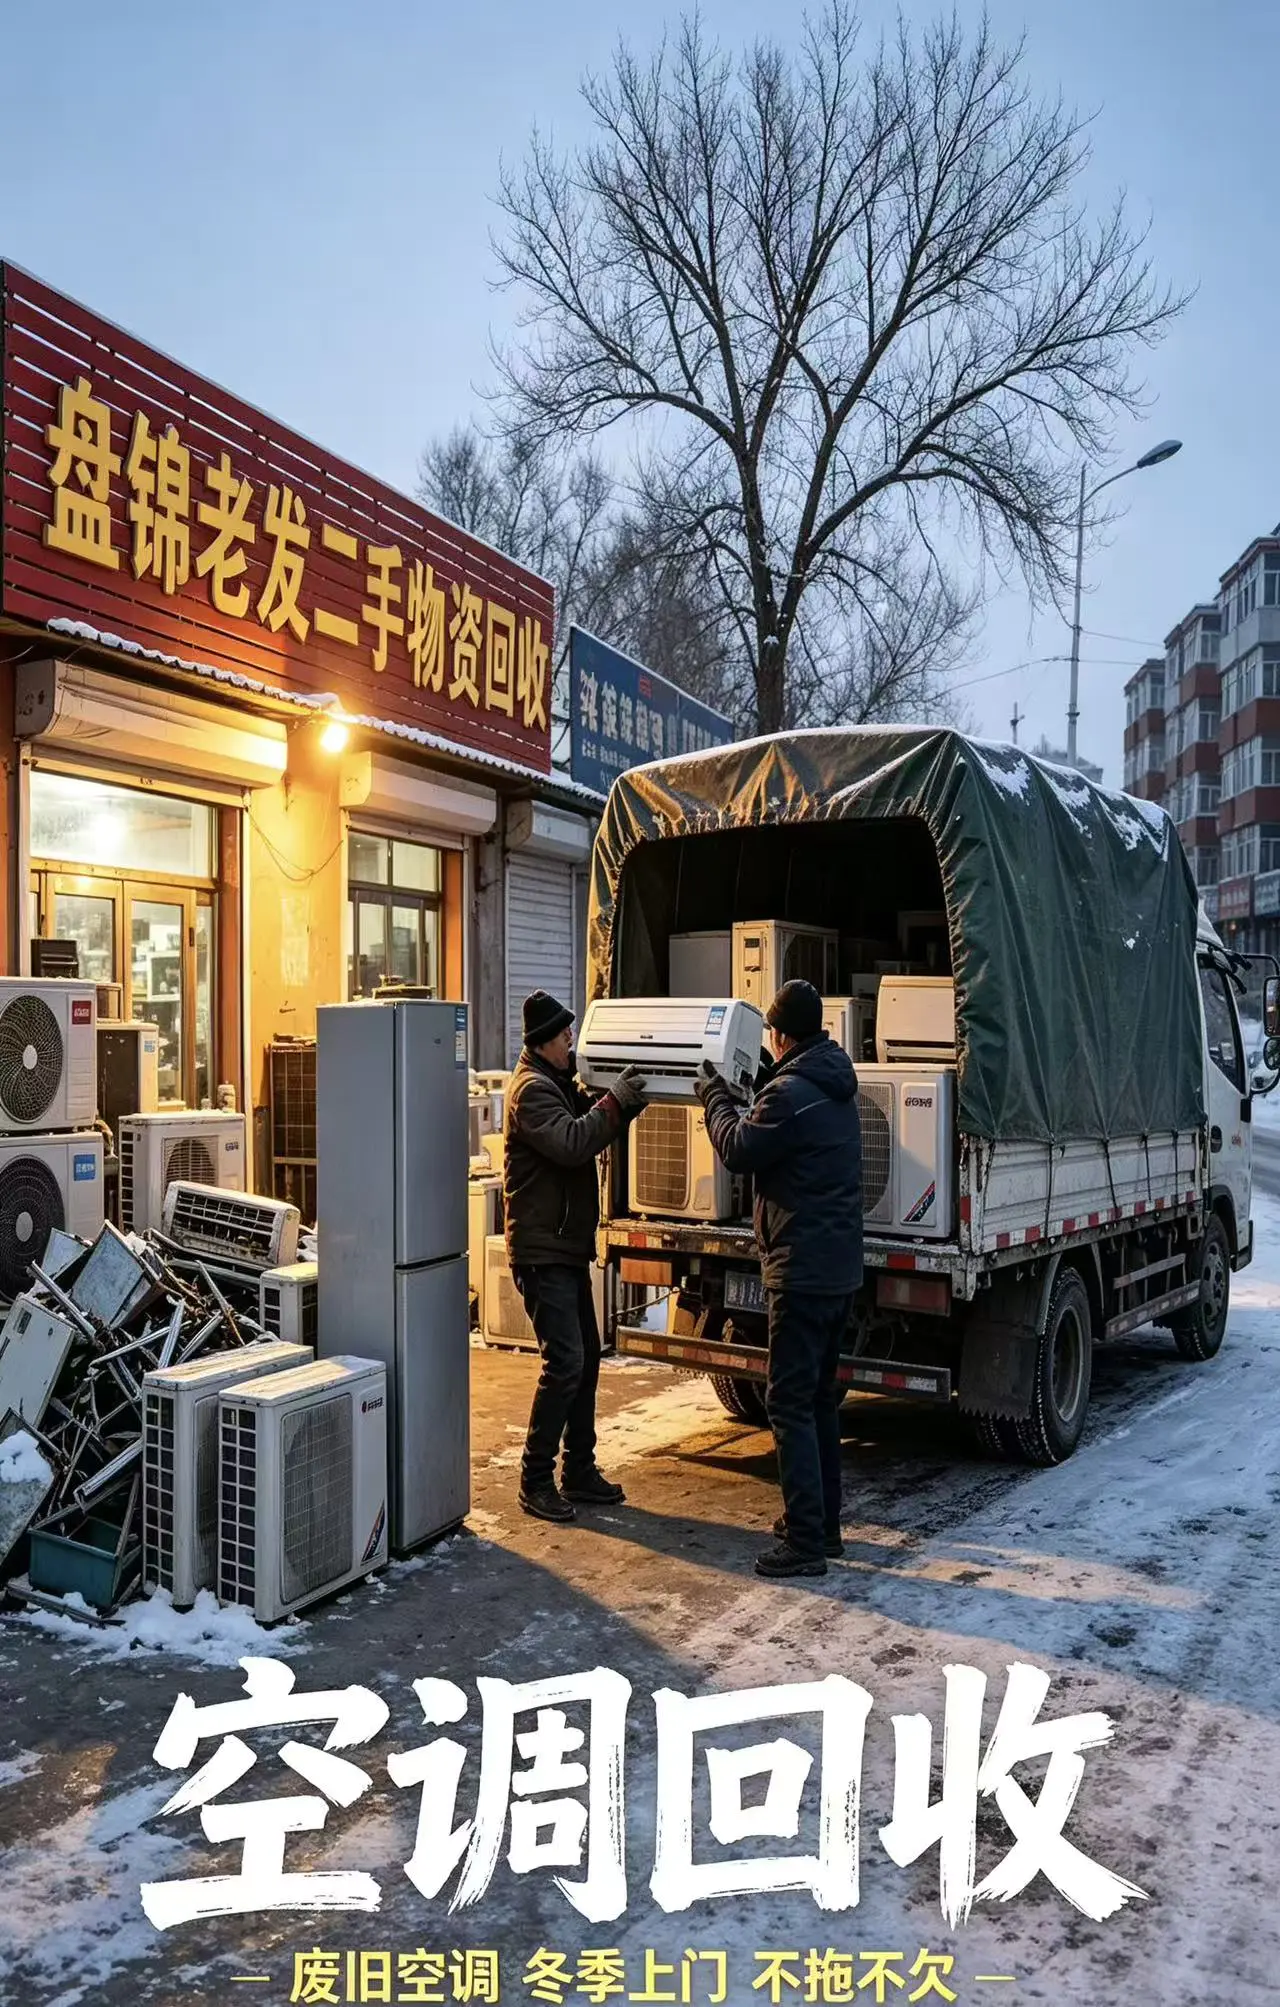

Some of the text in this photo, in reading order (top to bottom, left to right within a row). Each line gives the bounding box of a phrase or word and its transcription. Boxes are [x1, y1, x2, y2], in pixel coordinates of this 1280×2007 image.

[43, 376, 548, 730] 盘锦老发二手物资回收
